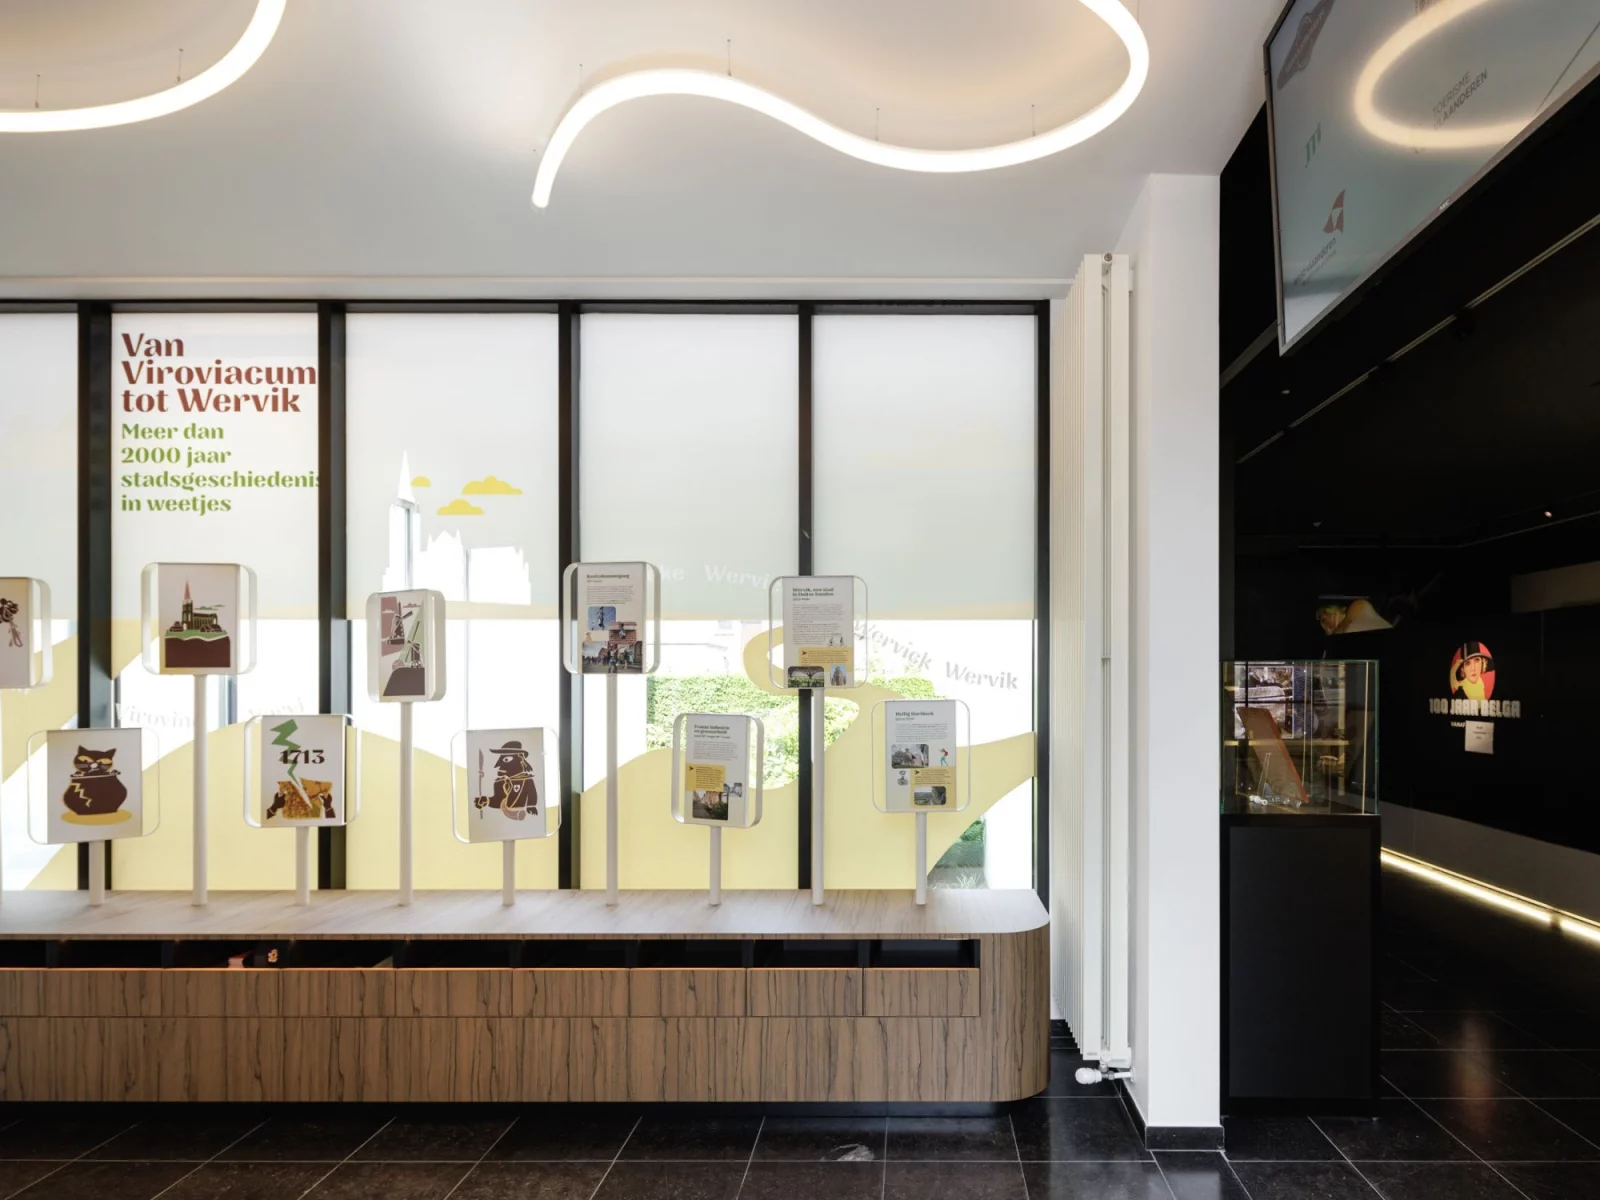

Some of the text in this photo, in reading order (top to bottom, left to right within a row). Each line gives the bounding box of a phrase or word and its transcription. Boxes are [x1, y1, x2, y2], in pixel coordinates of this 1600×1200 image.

[121, 333, 184, 357] Van
[121, 359, 316, 385] Viroviacum
[121, 387, 301, 413] tot Wervik
[121, 423, 224, 439] Meer dan
[121, 446, 232, 468] 2000 jaar
[121, 494, 232, 516] in weetjes
[946, 661, 1018, 690] Wervik
[1428, 698, 1520, 718] 100 JAAR BELGA
[280, 749, 325, 764] 1713
